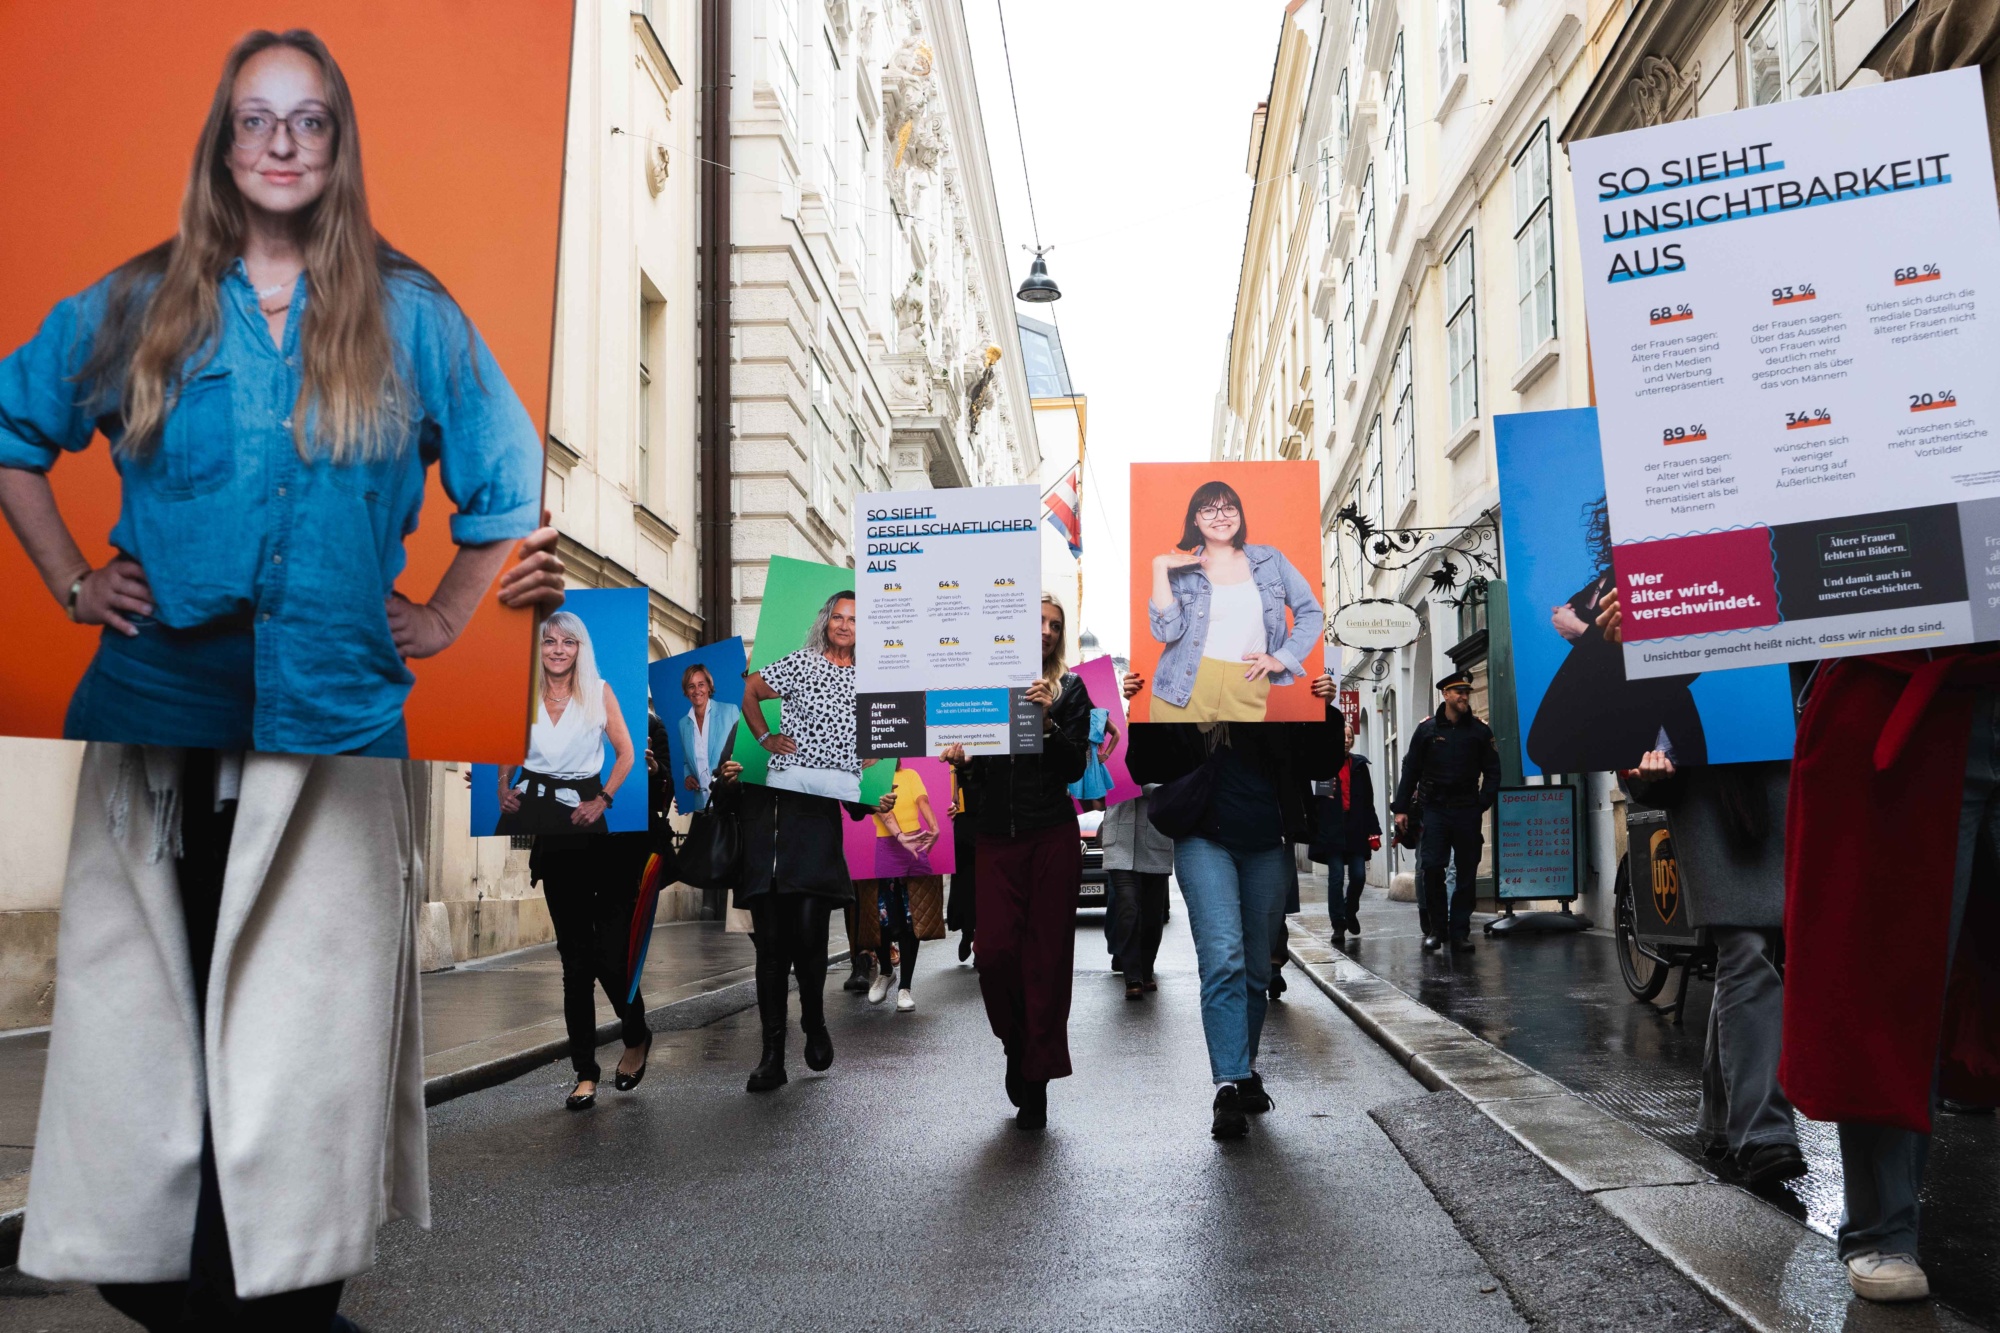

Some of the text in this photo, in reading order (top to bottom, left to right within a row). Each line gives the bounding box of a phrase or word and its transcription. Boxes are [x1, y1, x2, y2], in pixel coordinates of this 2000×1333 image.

[1598, 142, 1772, 200] SO SIEHT
[1603, 153, 1949, 240] UNSICHTBARKEIT
[1607, 243, 1685, 282] AUS
[1893, 262, 1940, 282] 68 %
[1771, 282, 1815, 302] 93 %
[1865, 288, 1975, 312] fühlen sich durch die
[1649, 303, 1693, 321] 68 %
[1869, 301, 1975, 323] mediale Darstellung
[1751, 312, 1842, 332] der Frauen sagen:
[1873, 312, 1976, 335] älterer Frauen nicht
[1630, 332, 1717, 352] der Frauen sagen:
[1750, 323, 1847, 344] Über das Aussehen
[1890, 327, 1959, 344] repräsentiert
[1631, 341, 1720, 363] Ältere Frauen sind
[1758, 334, 1841, 354] von Frauen wird
[1653, 362, 1673, 371] den
[1674, 356, 1712, 368] Medien
[1765, 348, 1837, 366] deutlich mehr
[1644, 367, 1712, 384] und Werbung
[1751, 357, 1853, 381] gesprochen als über
[1634, 376, 1724, 397] unterrepräsentiert
[1760, 370, 1848, 390] das von Männern
[1908, 389, 1956, 408] 20 %
[1785, 407, 1831, 426] 34 %
[1662, 423, 1706, 442] 89 %
[1896, 418, 1975, 436] wünschen sich
[1773, 435, 1849, 453] wünschen sich
[1887, 429, 1988, 449] mehr authentische
[1791, 450, 1833, 462] weniger
[1914, 444, 1963, 457] Vorbilder
[1643, 453, 1731, 472] der Frauen sagen:
[1780, 458, 1847, 476] Fixierung auf
[1656, 466, 1722, 481] Alter wird bei
[1775, 472, 1856, 488] Äußerlichkeiten
[1645, 476, 1735, 494] Frauen viel stärker
[1644, 487, 1739, 506] thematisiert als bei
[867, 506, 932, 521] SO SIEHT
[1670, 502, 1715, 514] Männern
[867, 518, 1032, 538] GESELLSCHAFTLICHER
[867, 541, 920, 555] DRUCK
[1830, 533, 1895, 547] Ältere Frauen
[1824, 545, 1906, 561] fehlen in Bildern.
[866, 559, 896, 572] AUS
[1627, 572, 1664, 587] Wer
[1824, 569, 1911, 587] Und damit auch in
[1630, 580, 1724, 604] älter wird,
[1819, 582, 1922, 600] unseren Geschichten.
[1631, 594, 1761, 620] verschwindet.
[1385, 619, 1411, 627] Tempo
[1643, 620, 1945, 663] Unsichtbar gemacht heißt nicht, dass wir nicht da sind.
[871, 717, 908, 725] natürlich.
[871, 725, 894, 733] Druck
[871, 741, 908, 750] gemacht.
[1502, 793, 1564, 804] Special SALE
[1653, 859, 1677, 909] ups
